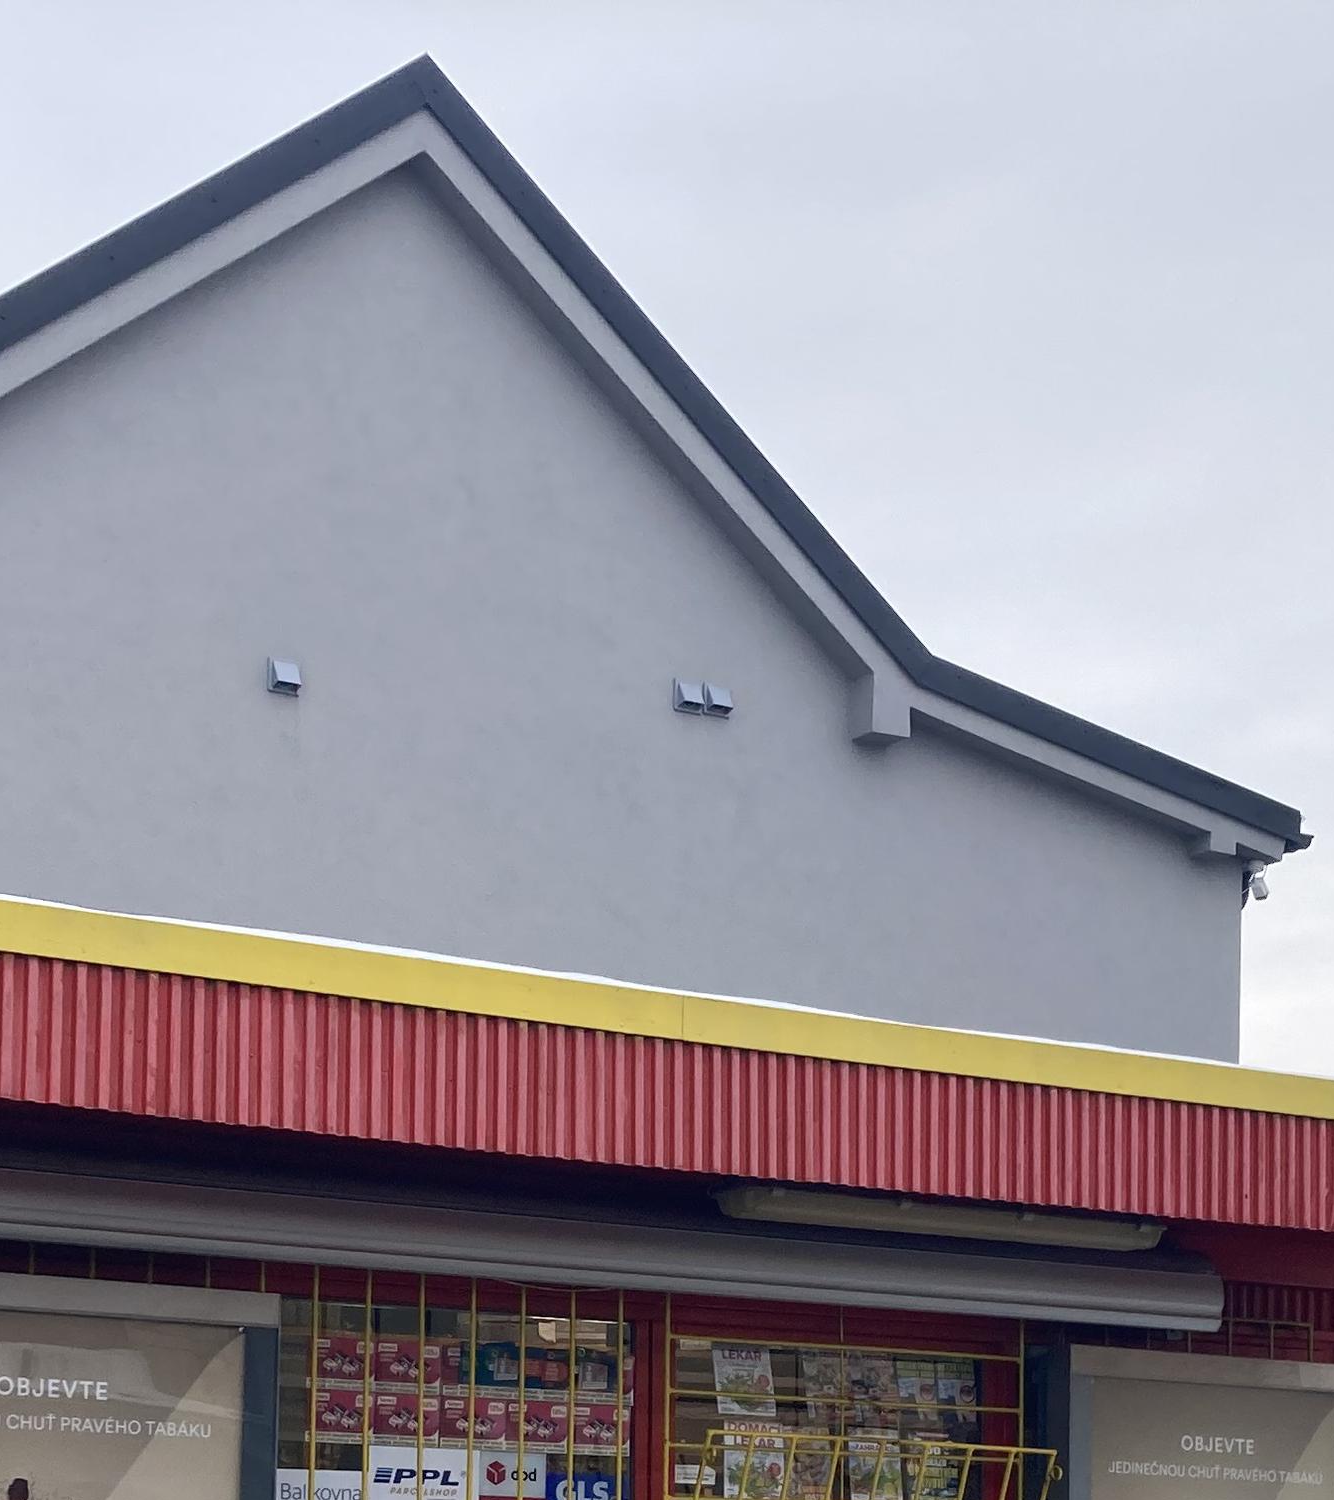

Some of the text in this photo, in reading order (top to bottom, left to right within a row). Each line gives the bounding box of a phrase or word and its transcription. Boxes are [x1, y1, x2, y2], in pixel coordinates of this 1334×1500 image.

[7, 1413, 57, 1432] CHUŤ
[60, 1416, 141, 1435] PRAVÉHO
[145, 1420, 212, 1438] TABÁKU
[1181, 1435, 1255, 1455] OBJEVTE
[393, 1468, 460, 1487] PPL
[1108, 1460, 1185, 1478] JEDINEČNOU
[1188, 1464, 1220, 1479] CHUŤ
[1222, 1467, 1276, 1482] PRAVÉHO
[280, 1482, 362, 1500] Balkovna
[390, 1486, 458, 1497] PARCLSHOP
